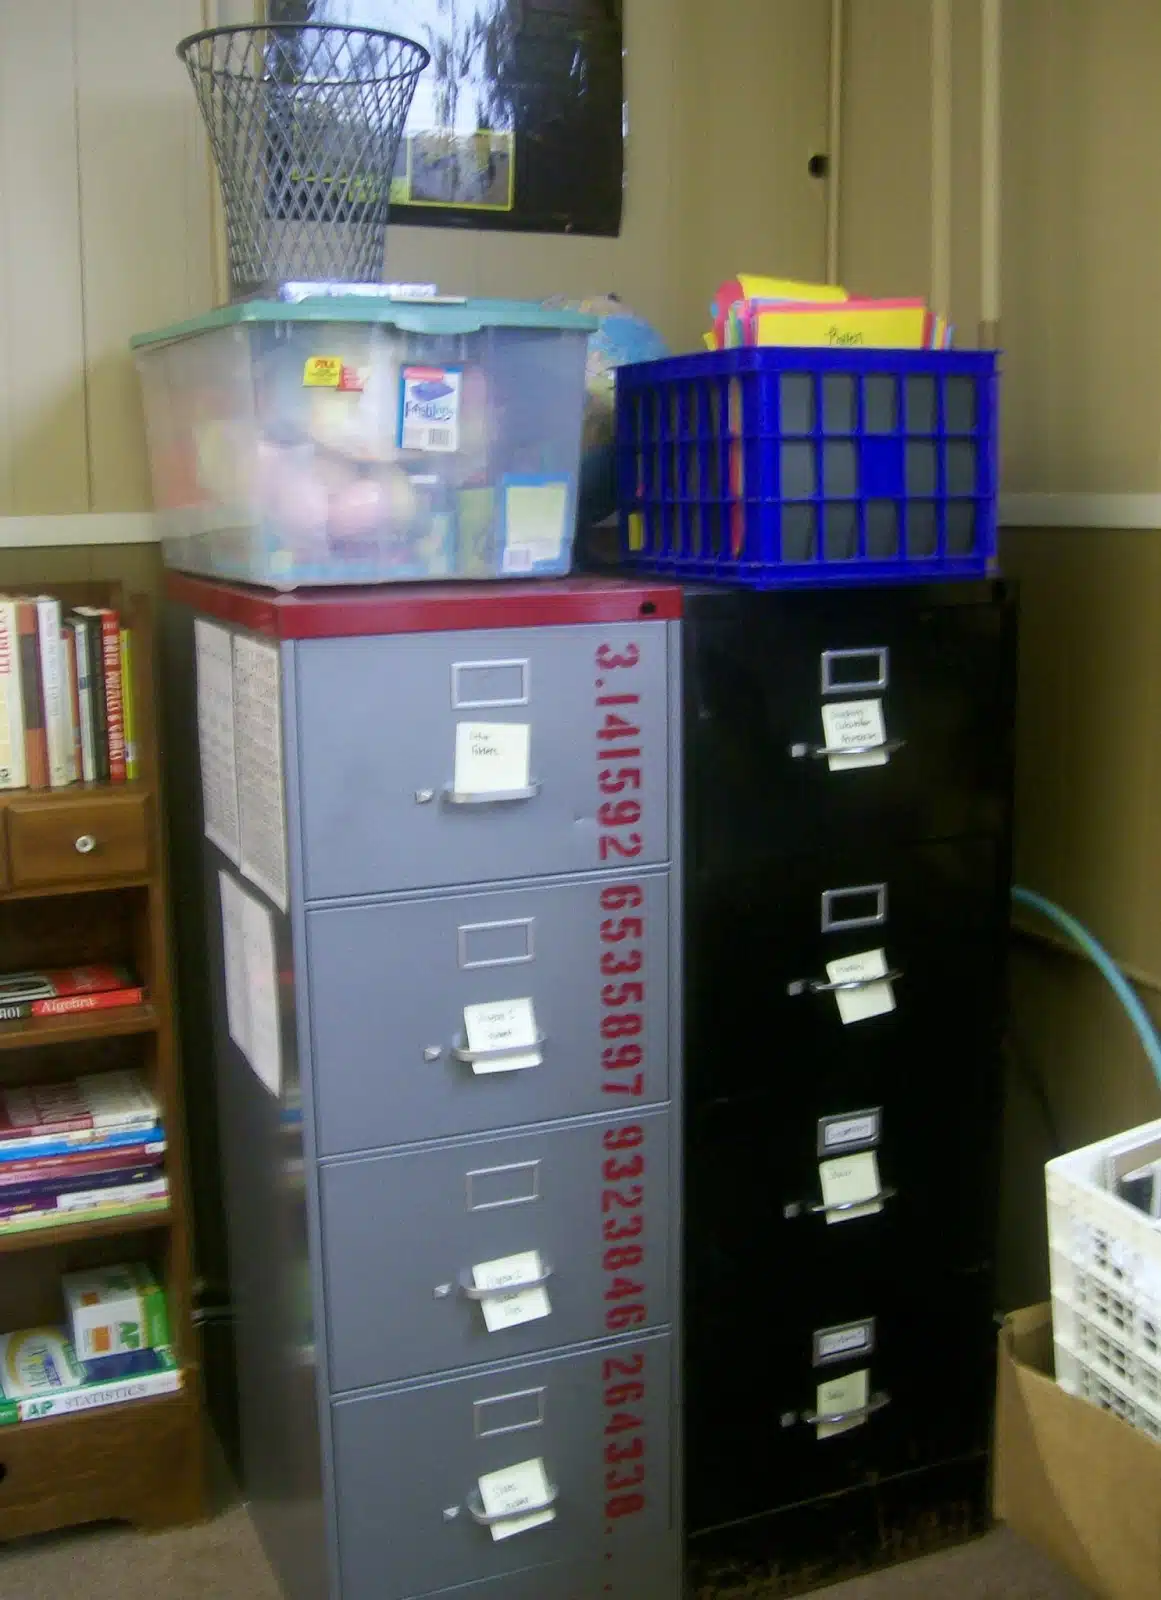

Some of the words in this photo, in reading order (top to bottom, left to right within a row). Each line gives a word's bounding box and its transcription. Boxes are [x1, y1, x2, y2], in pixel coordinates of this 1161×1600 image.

[104, 635, 119, 666] MATH
[107, 671, 122, 712] PUZZLES
[595, 643, 642, 860] 3.141592
[599, 884, 646, 1097] 6535897
[601, 1125, 647, 1330] 9323846
[65, 1384, 146, 1406] STATISTICS
